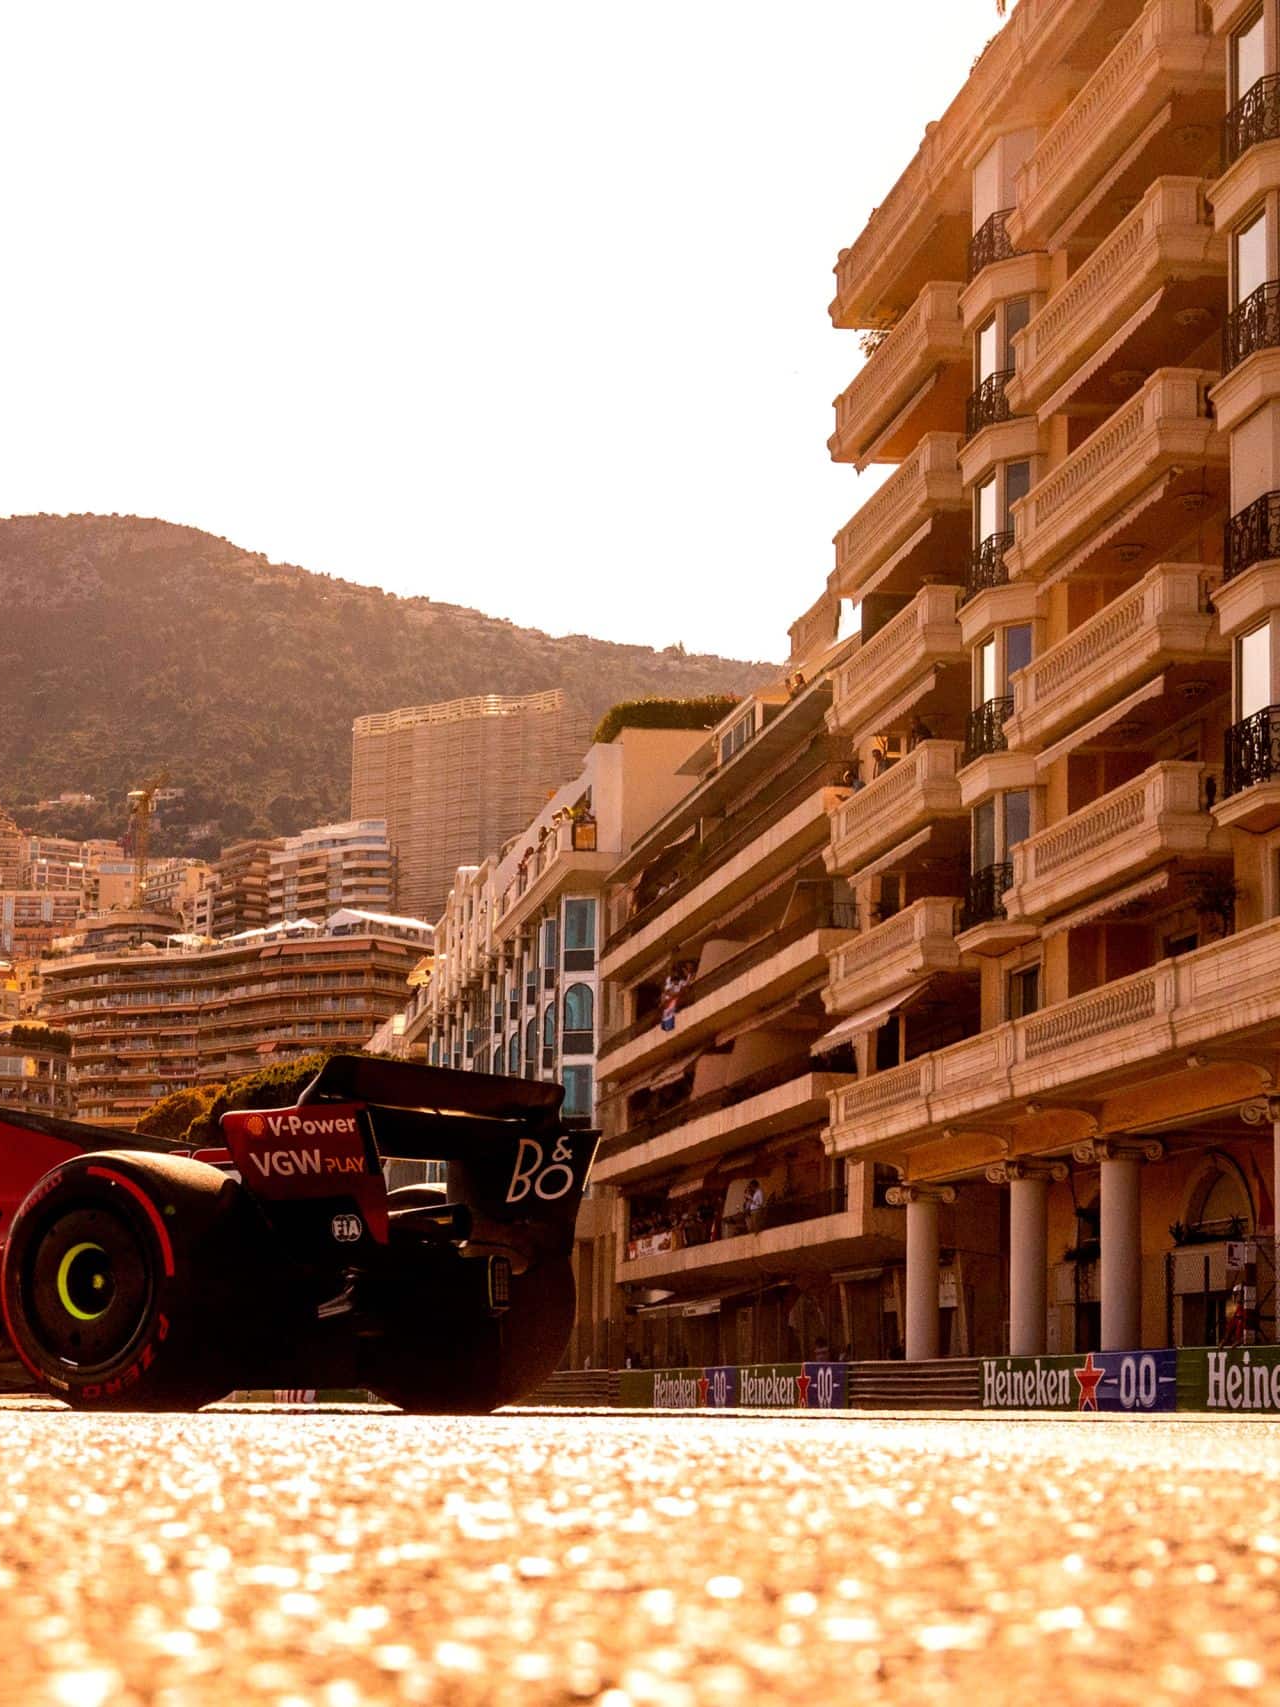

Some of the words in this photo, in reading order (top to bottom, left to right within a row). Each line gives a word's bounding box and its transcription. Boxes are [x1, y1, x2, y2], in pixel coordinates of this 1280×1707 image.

[268, 1115, 356, 1137] V-Power
[249, 1149, 321, 1177] VGW
[324, 1157, 366, 1174] PLAY
[654, 1372, 697, 1408] Heineken
[740, 1368, 795, 1405] Heineken
[982, 1359, 1071, 1407] Heineken
[1120, 1354, 1156, 1408] 0.0
